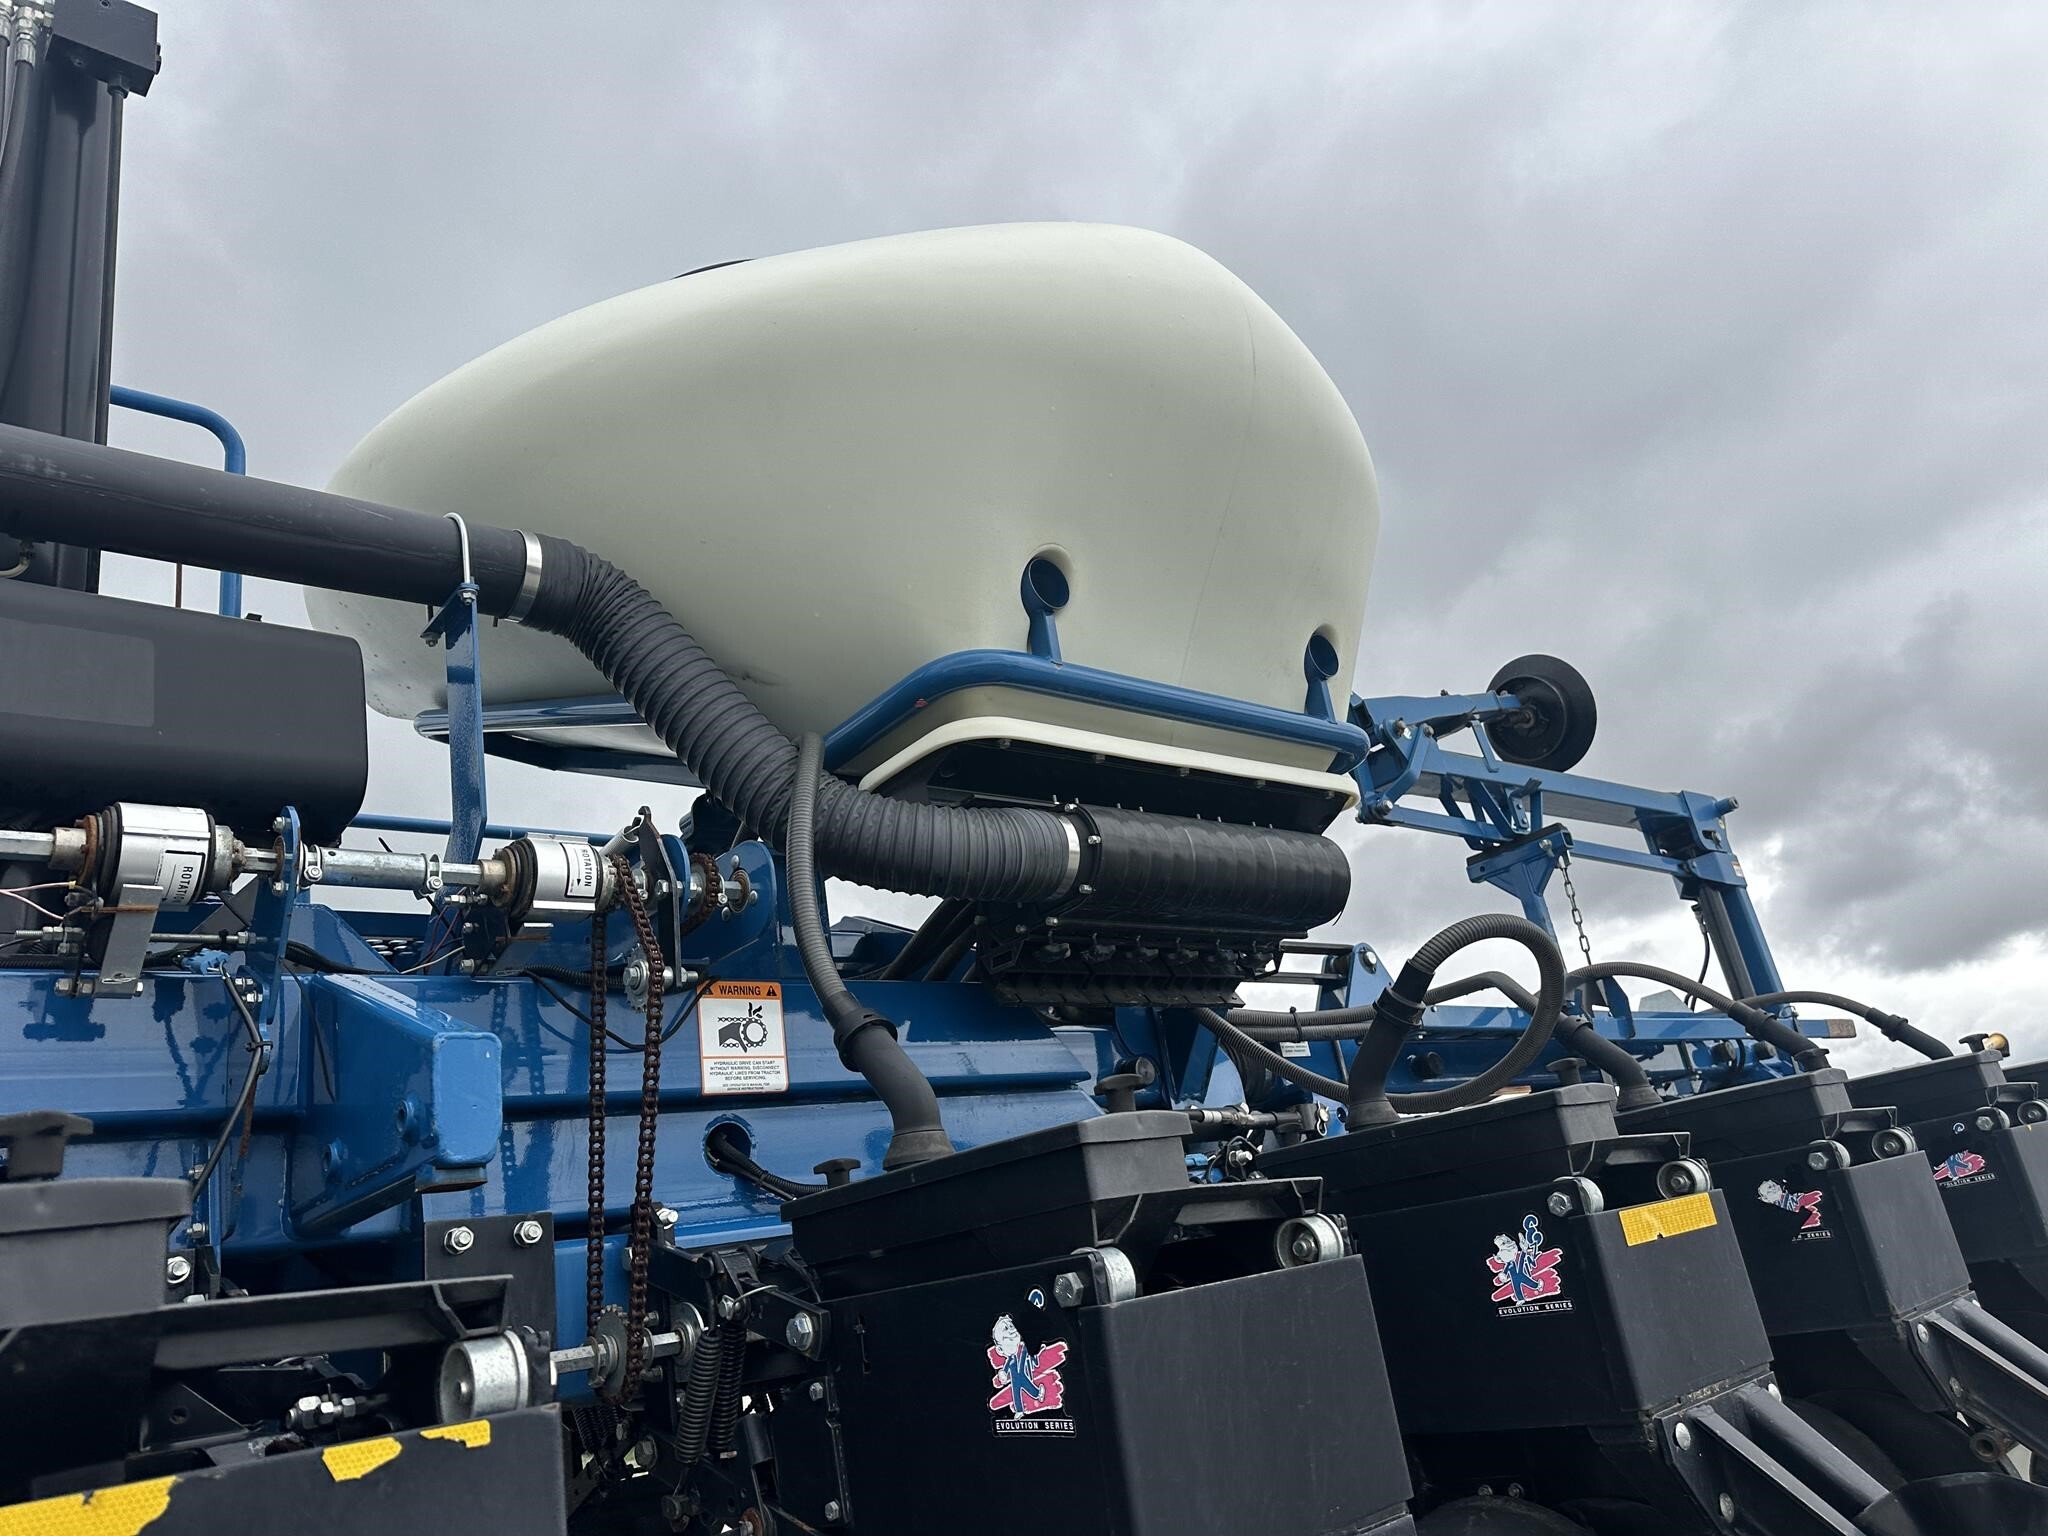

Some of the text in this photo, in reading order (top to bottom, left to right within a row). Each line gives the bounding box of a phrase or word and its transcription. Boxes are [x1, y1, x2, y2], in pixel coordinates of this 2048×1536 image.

[719, 985, 761, 996] WARNING
[1498, 1302, 1573, 1315] EVOLUTION SERIES
[996, 1421, 1074, 1430] EVOLUTION SERIES
